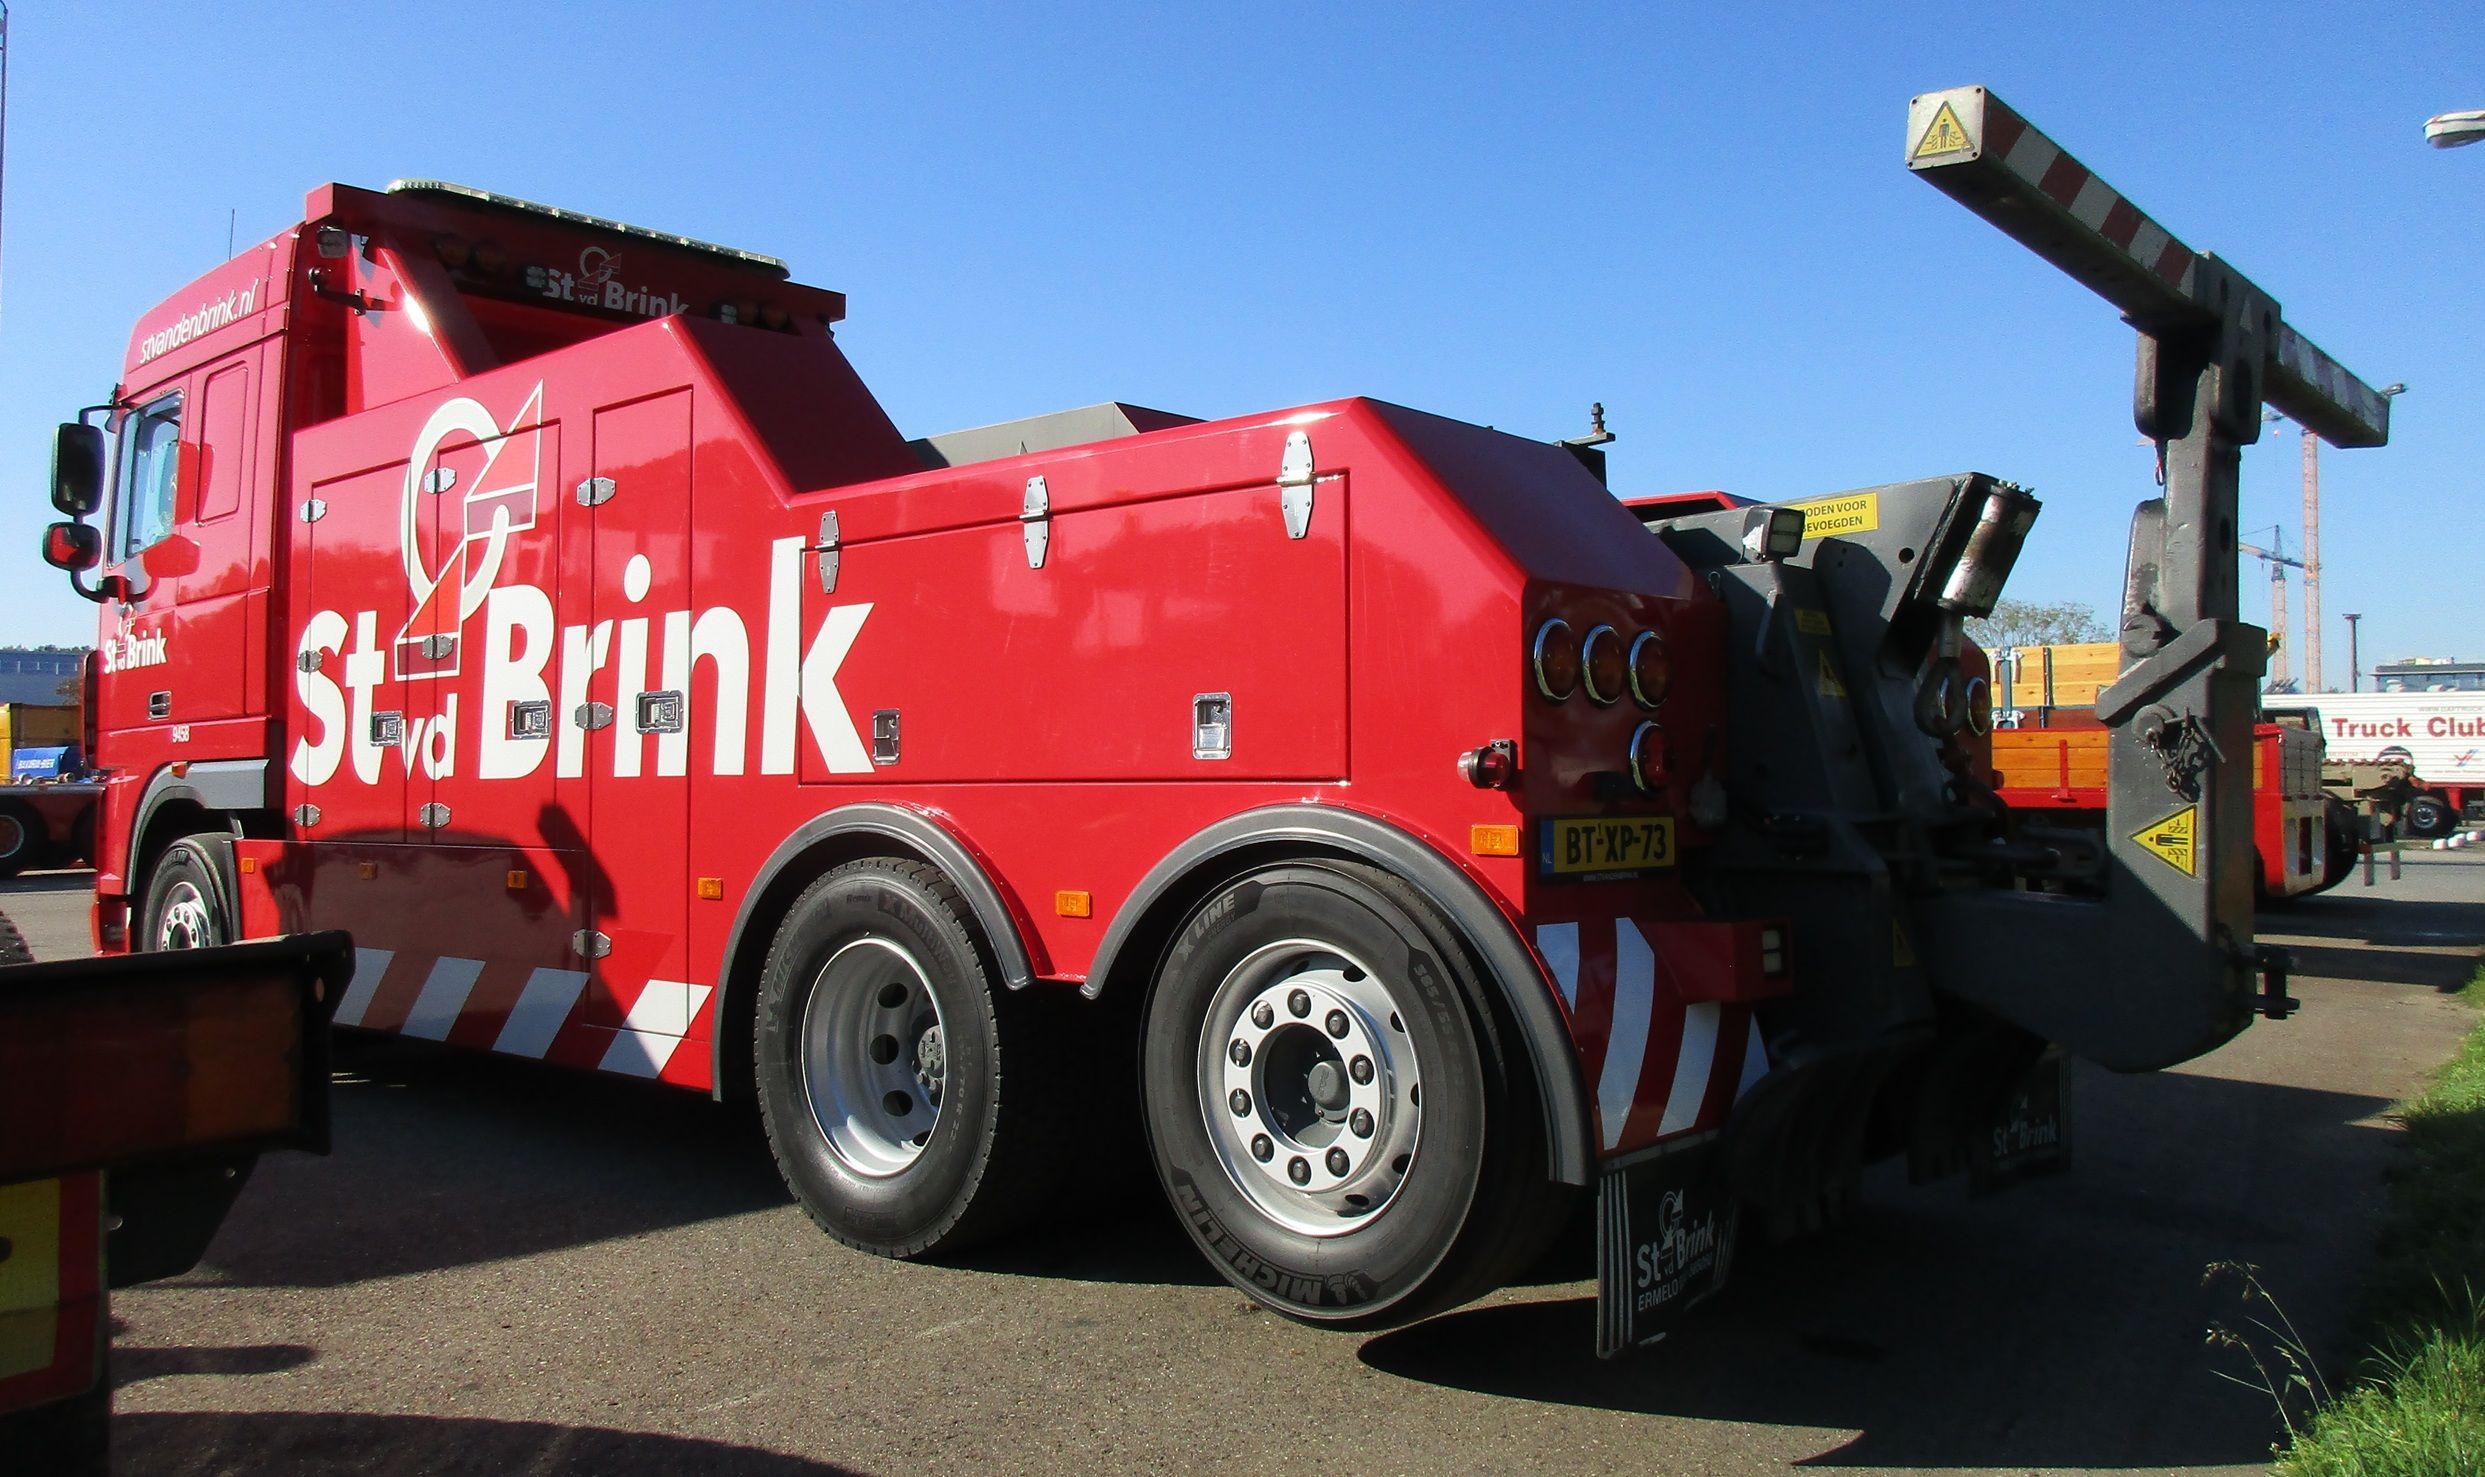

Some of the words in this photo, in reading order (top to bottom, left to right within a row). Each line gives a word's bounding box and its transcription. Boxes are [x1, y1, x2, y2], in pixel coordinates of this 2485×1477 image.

[542, 268, 575, 301] St
[579, 293, 599, 306] vd
[604, 280, 690, 317] Brink
[139, 277, 261, 365] stvandenbrink.nl
[1803, 515, 1863, 533] EVOEGDEN
[1836, 500, 1867, 513] VOOR
[104, 638, 117, 674] St
[126, 626, 168, 670] Brink
[290, 609, 385, 787] St
[401, 693, 456, 782] vd
[479, 535, 876, 780] Brink
[172, 725, 190, 743] 9458
[2331, 717, 2413, 738] Truck
[1541, 852, 1553, 865] NL
[1566, 822, 1667, 865] BT-XP-73
[1177, 937, 1196, 962] X
[1194, 893, 1236, 939] LINE
[1177, 1183, 1324, 1306] MICHELIN
[1637, 1241, 1662, 1288] St
[1676, 1208, 1714, 1271] Brink
[1637, 1277, 1680, 1313] ERMELO
